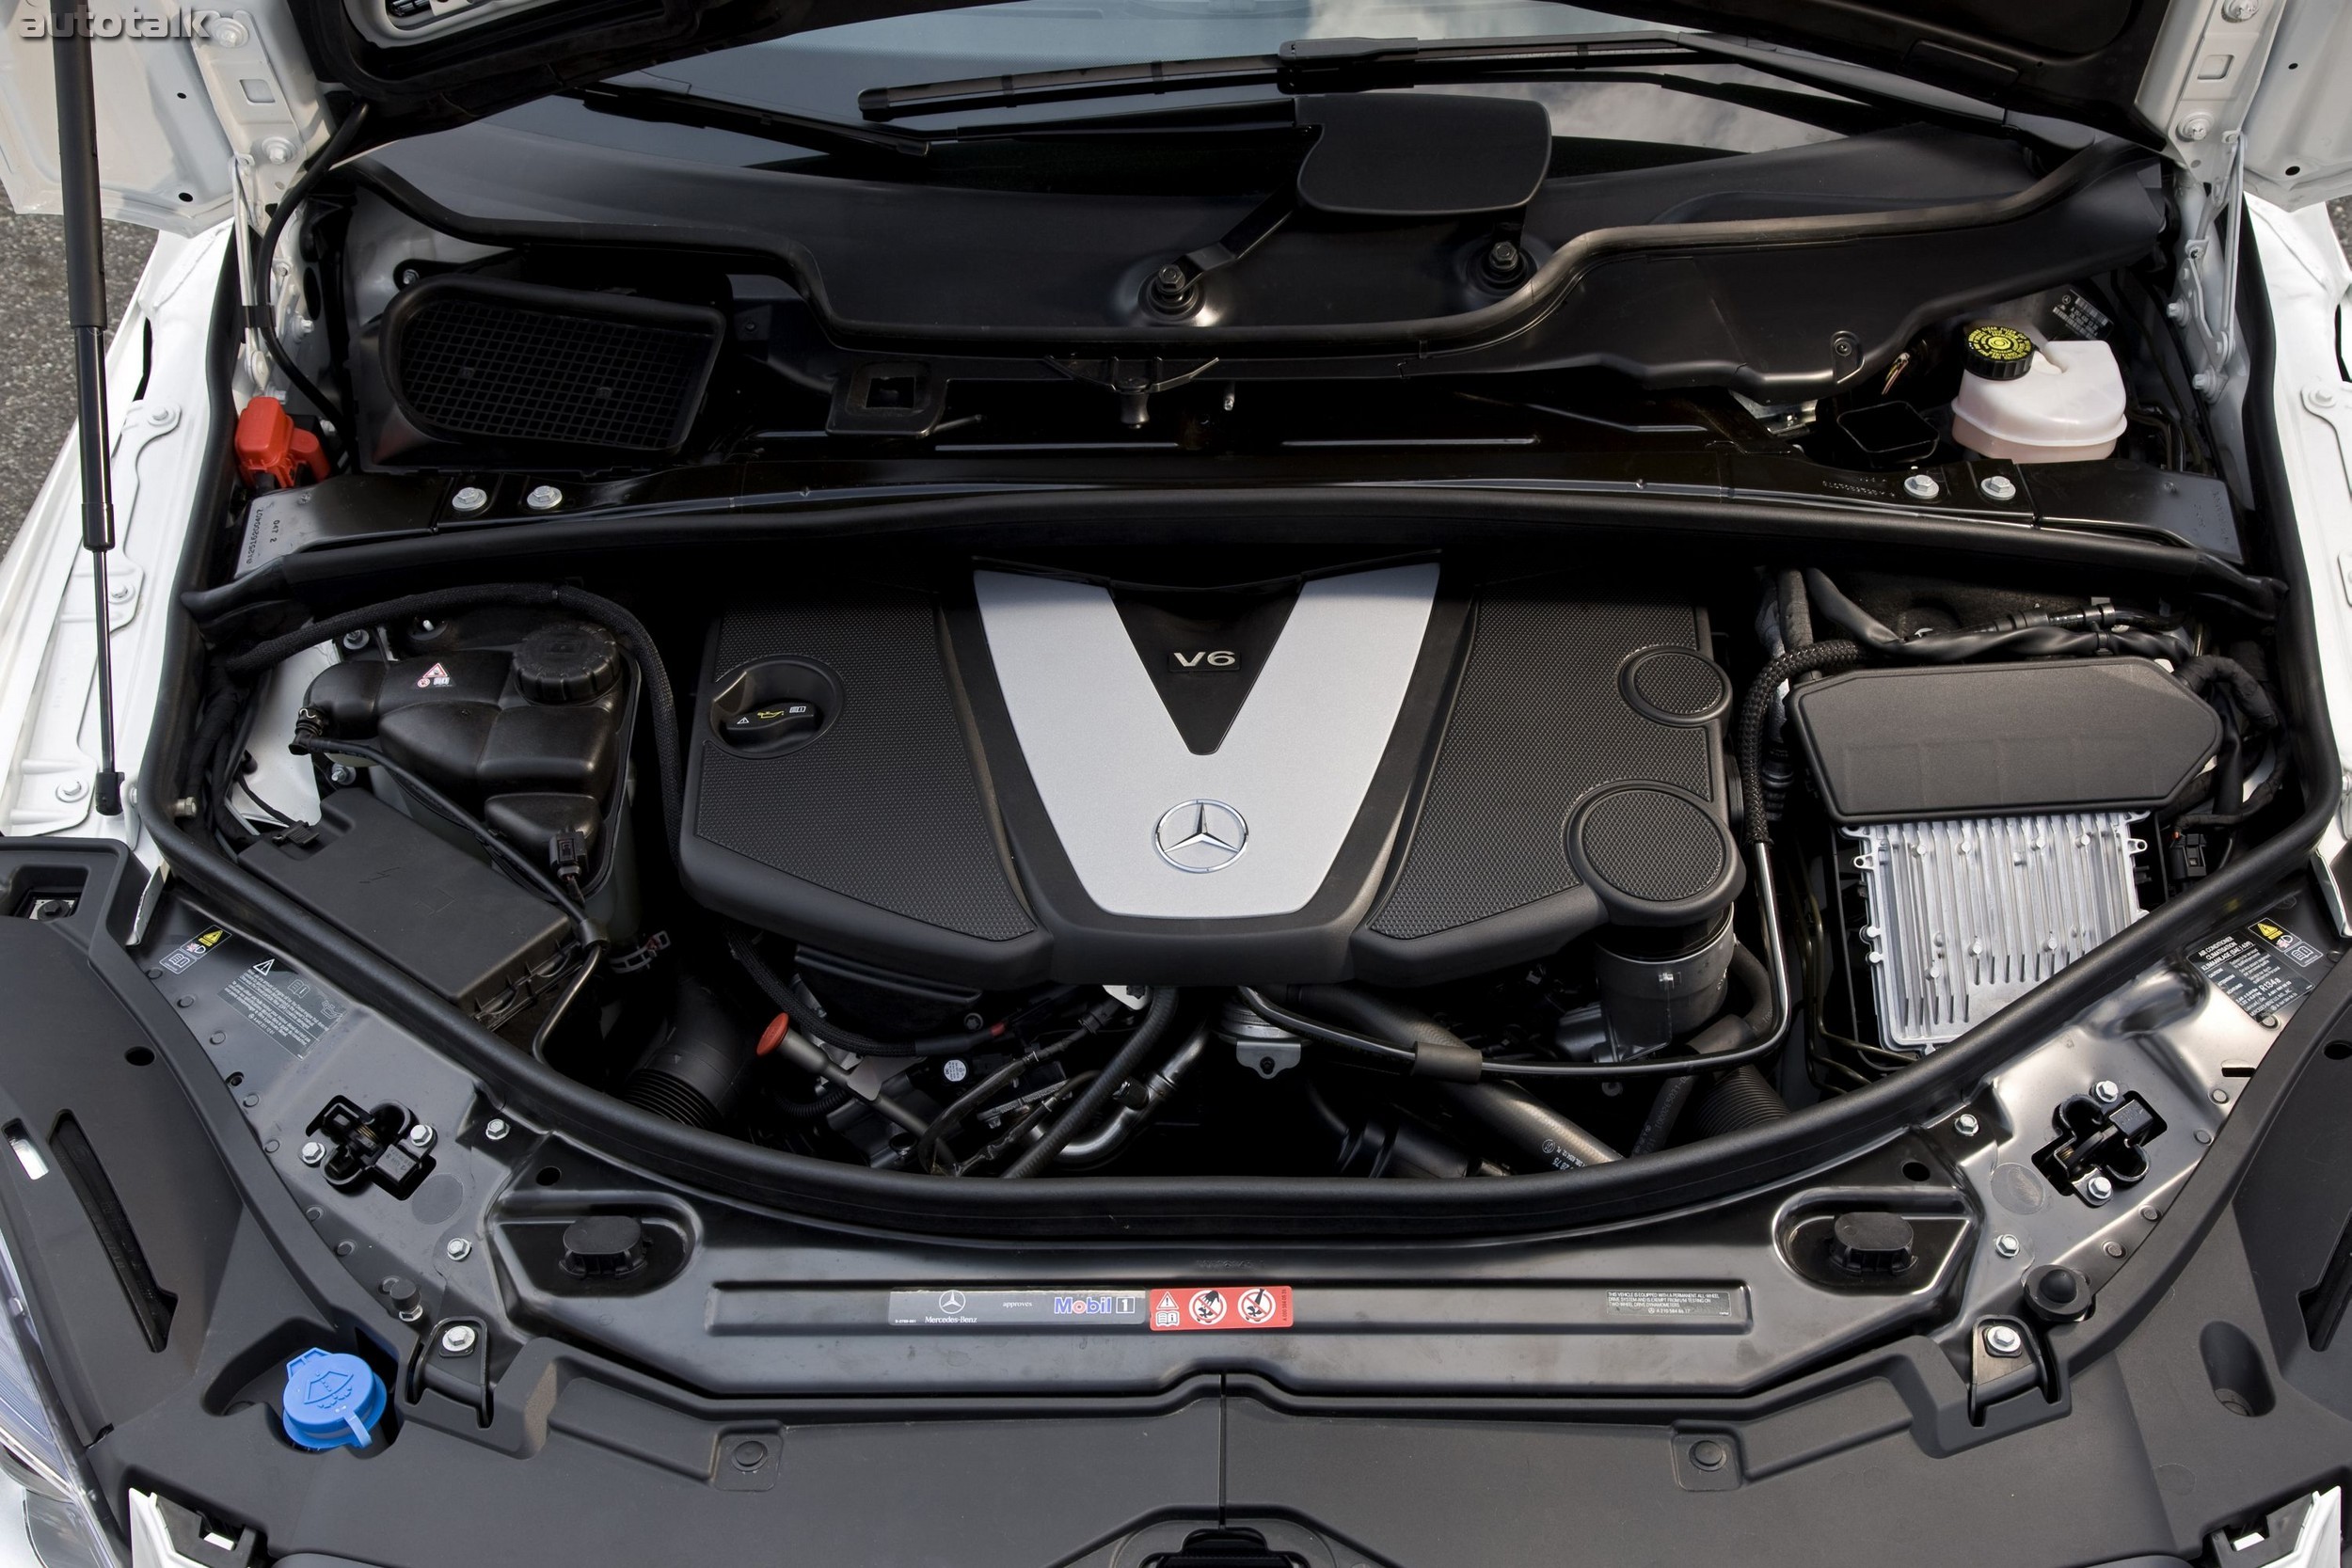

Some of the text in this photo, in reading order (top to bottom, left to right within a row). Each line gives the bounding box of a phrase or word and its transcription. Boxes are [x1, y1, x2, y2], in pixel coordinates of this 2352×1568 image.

[1173, 650, 1235, 668] V6
[2204, 936, 2233, 953] CONDITIONER
[2257, 976, 2281, 992] R134a
[1054, 1297, 1112, 1314] Mobil
